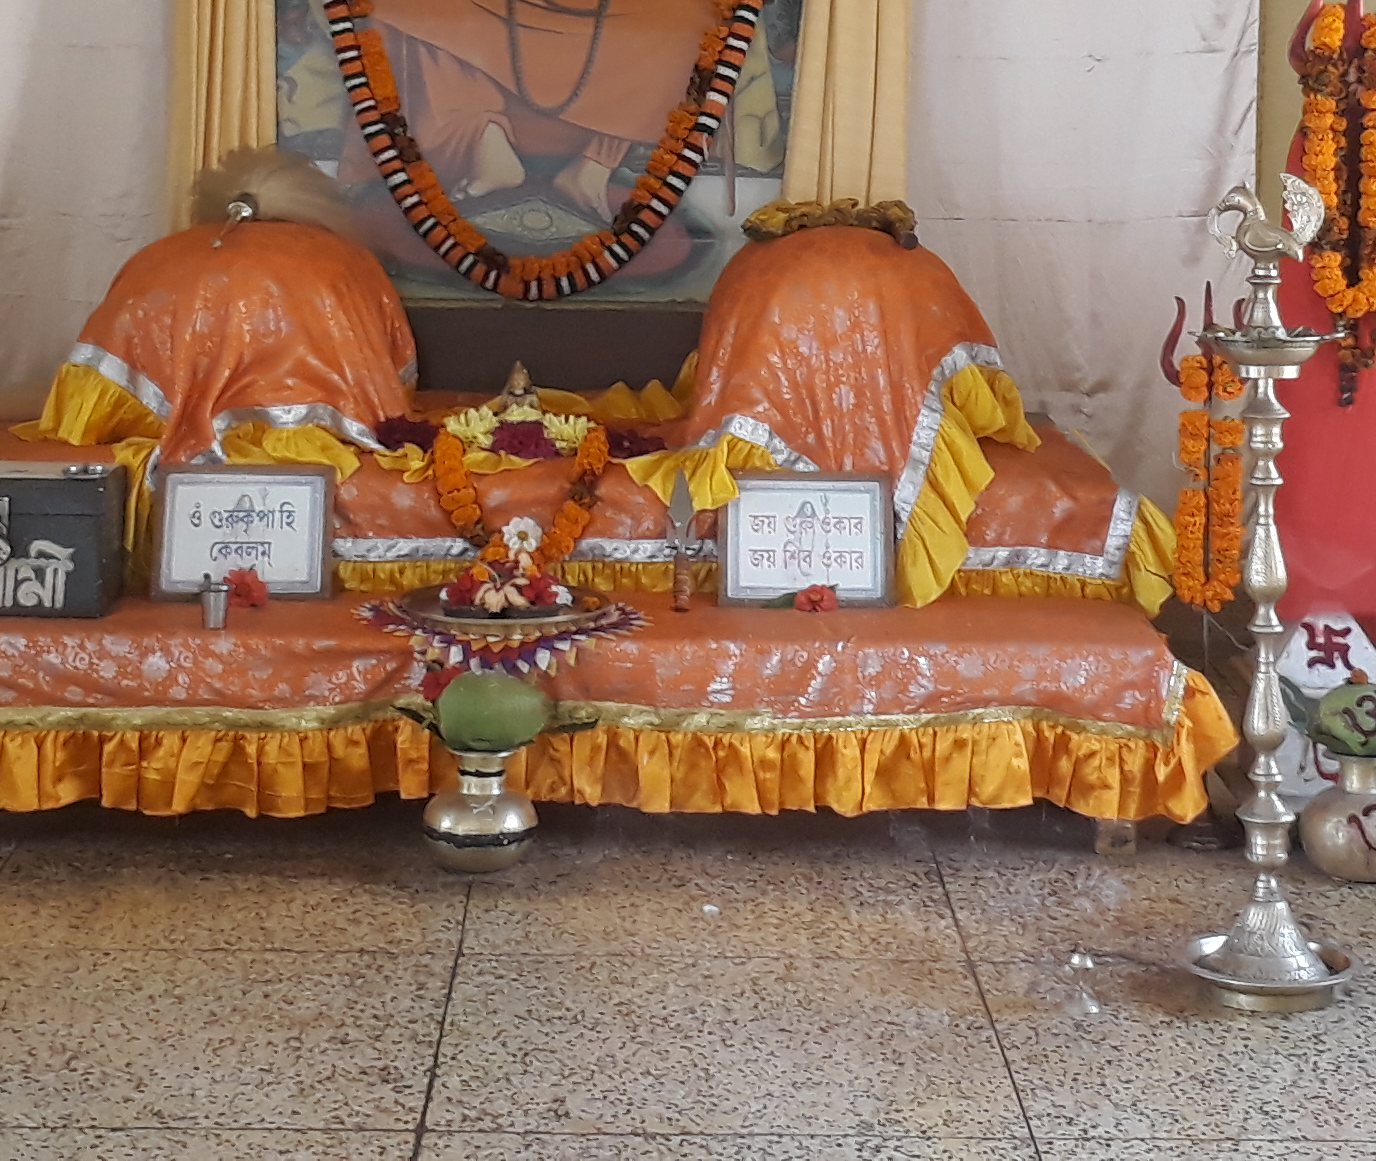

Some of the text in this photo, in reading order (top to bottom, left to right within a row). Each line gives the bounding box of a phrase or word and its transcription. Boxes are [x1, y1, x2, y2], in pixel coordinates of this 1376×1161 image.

[748, 514, 777, 534] জয়
[784, 515, 816, 535] গুরু
[210, 541, 273, 568] কেবলম্
[748, 549, 777, 569] জয়
